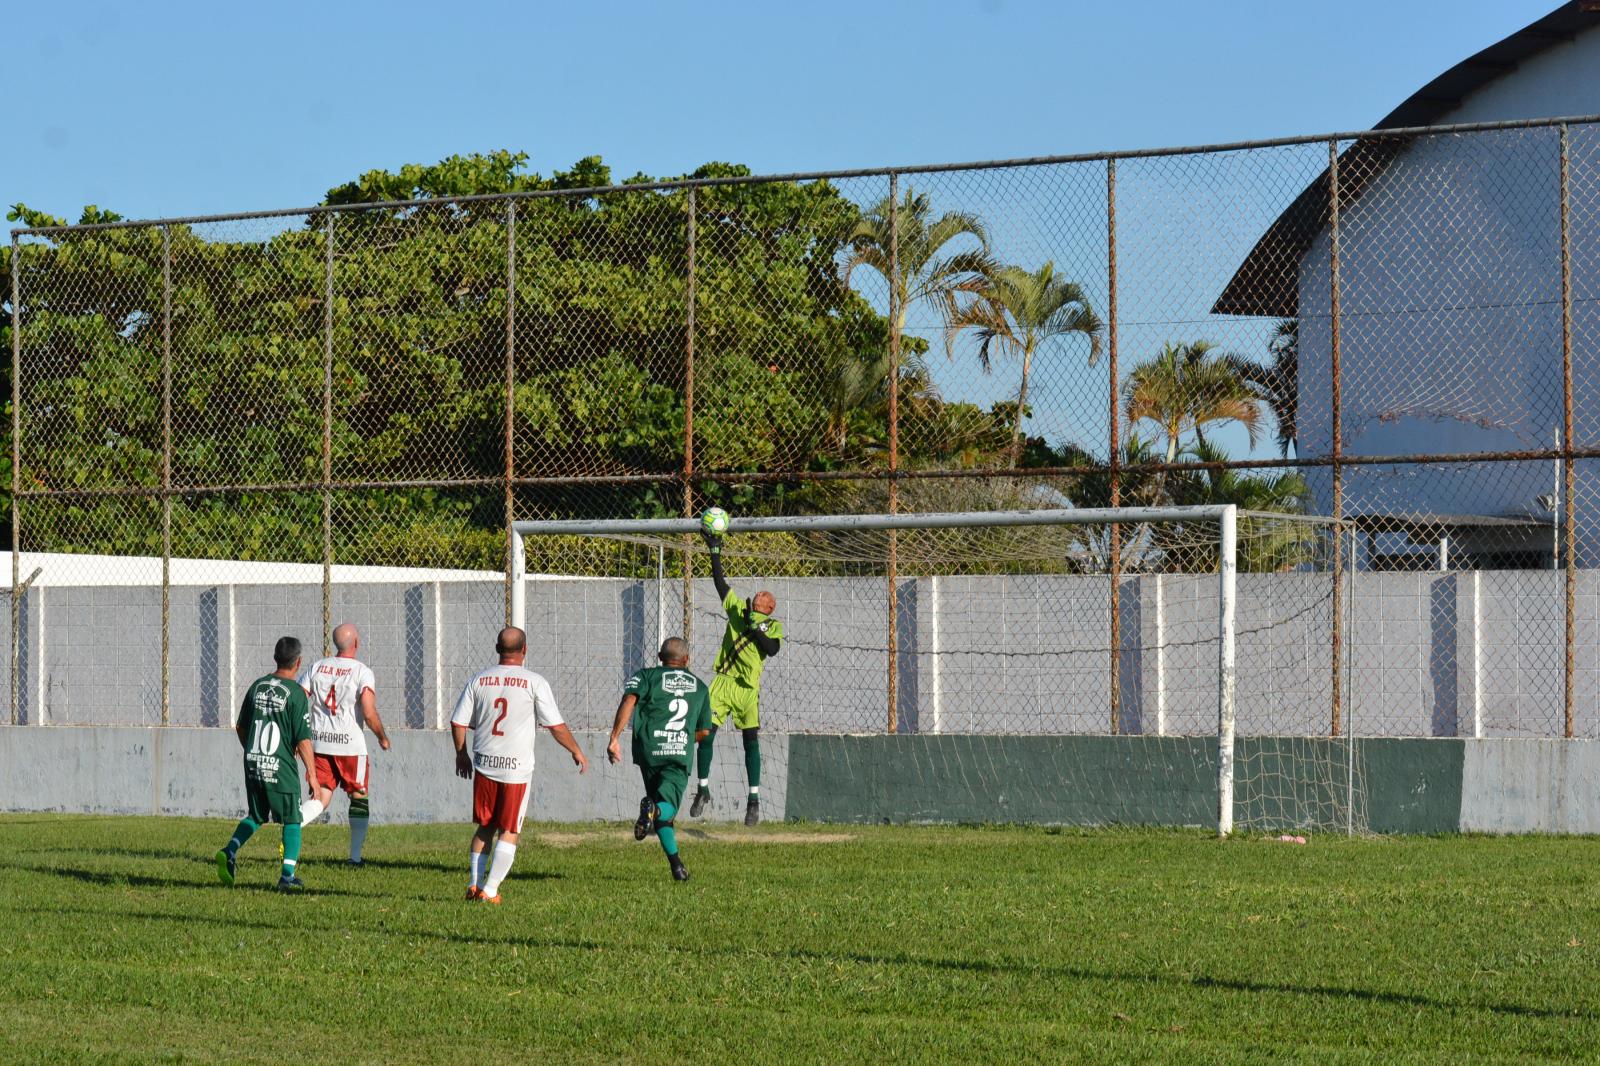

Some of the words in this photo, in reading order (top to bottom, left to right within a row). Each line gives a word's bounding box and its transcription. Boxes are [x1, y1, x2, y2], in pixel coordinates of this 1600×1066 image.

[480, 676, 500, 687] VILA
[504, 677, 528, 689] NOVA
[324, 684, 337, 717] 4
[491, 697, 508, 737] 2
[664, 698, 689, 731] 2
[250, 719, 281, 756] 10
[320, 732, 349, 744] PEDRAS
[483, 755, 517, 770] PEDRAS
